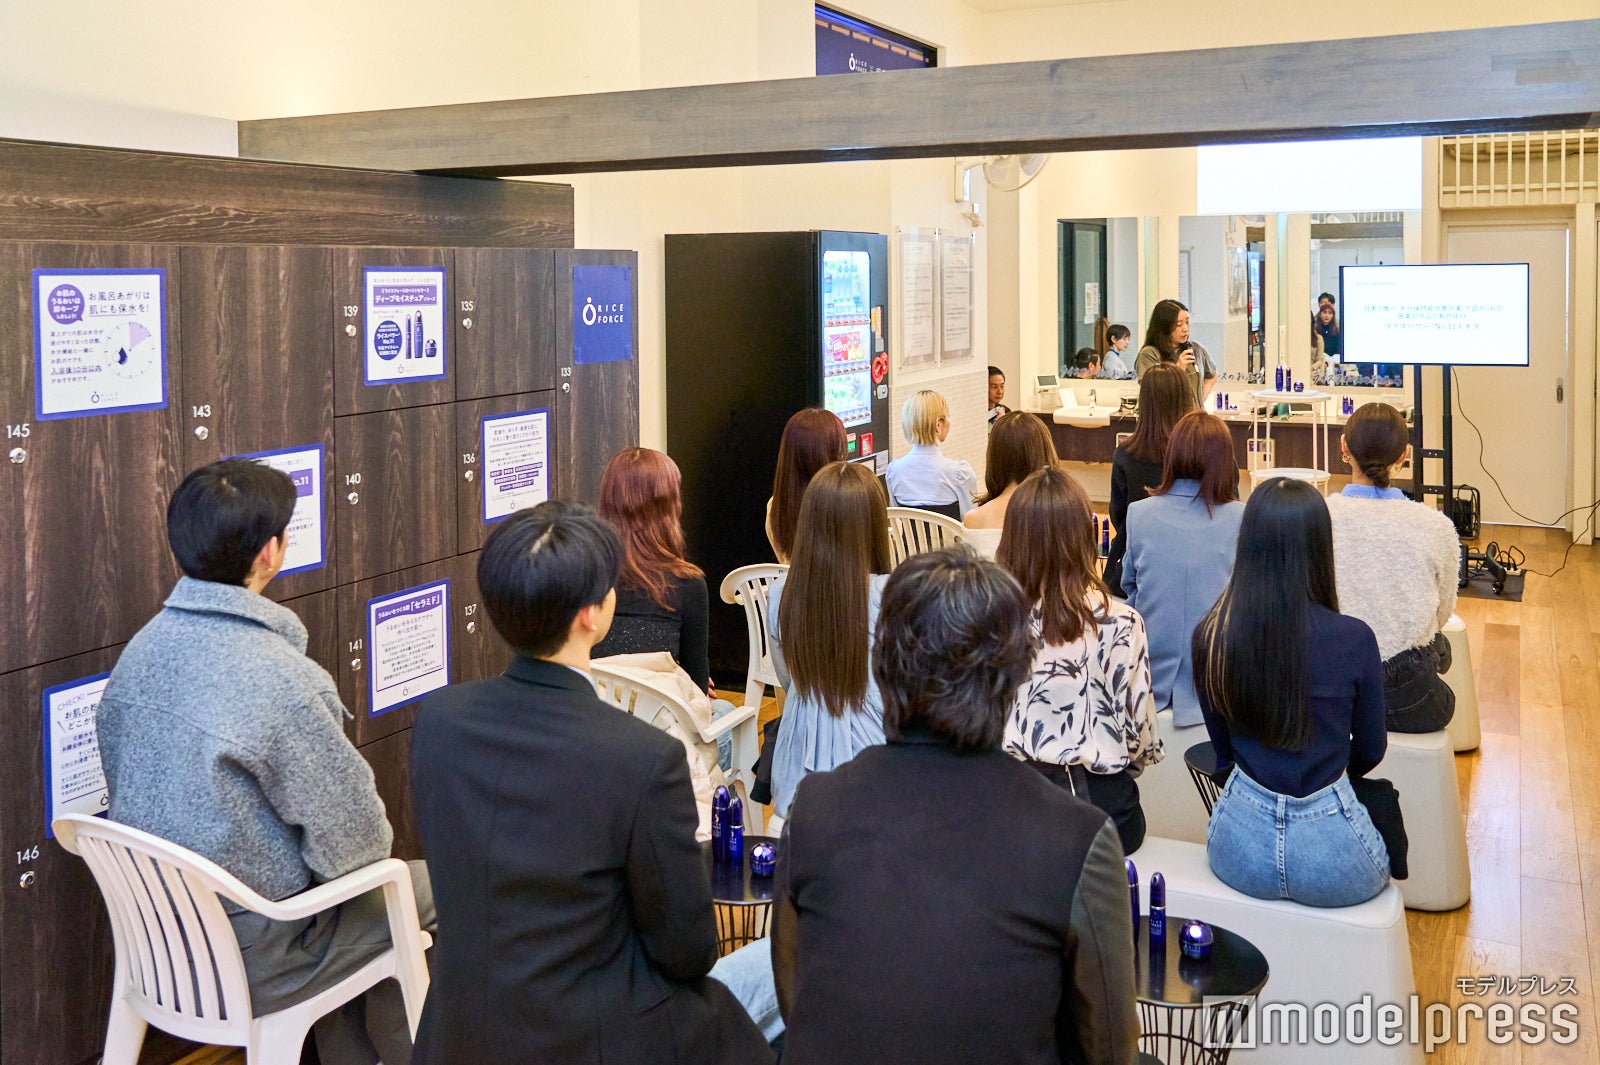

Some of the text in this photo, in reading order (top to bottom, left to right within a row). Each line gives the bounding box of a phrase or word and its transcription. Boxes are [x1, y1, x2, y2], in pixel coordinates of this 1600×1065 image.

[89, 291, 150, 300] お風呂あがりは
[344, 305, 358, 317] 139
[461, 300, 474, 311] 135
[598, 304, 624, 312] RICE
[598, 315, 624, 324] FORCE
[561, 366, 571, 377] 133
[192, 404, 211, 418] 143
[6, 423, 30, 438] 145
[463, 452, 476, 464] 136
[346, 472, 361, 486] 140
[464, 604, 477, 616] 137
[348, 639, 362, 652] 141
[16, 845, 40, 864] 146
